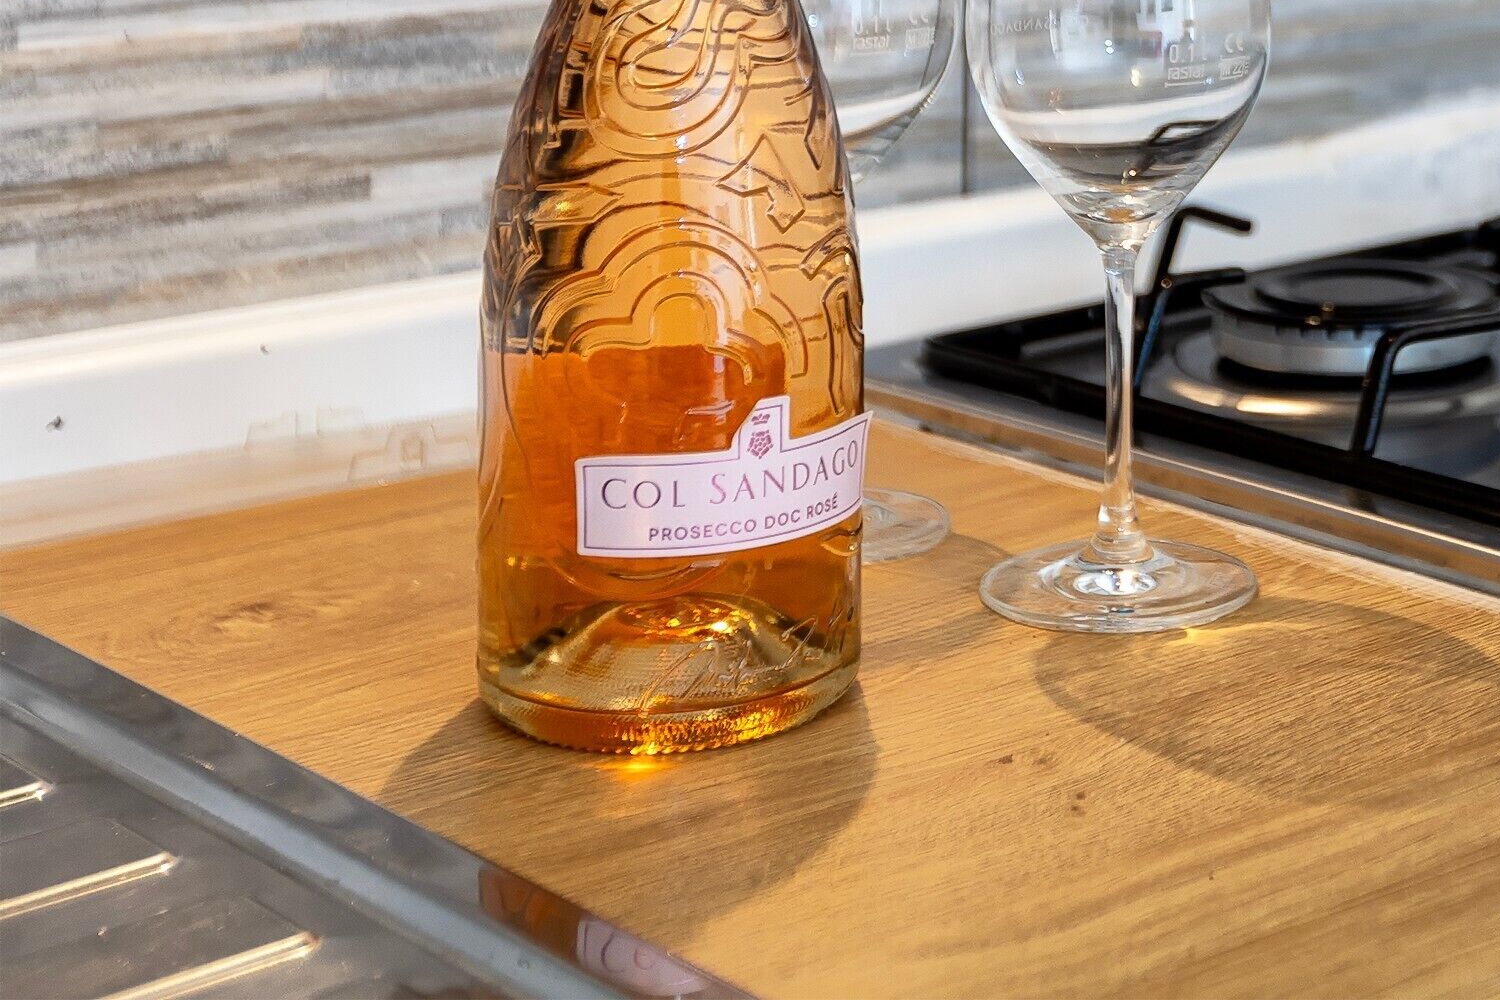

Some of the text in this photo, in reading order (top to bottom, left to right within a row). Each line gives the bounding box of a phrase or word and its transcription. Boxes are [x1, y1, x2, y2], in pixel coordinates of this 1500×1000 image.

[601, 439, 858, 509] COL SANDAGO
[649, 492, 838, 541] PROSECCO DOC ROSÉ
